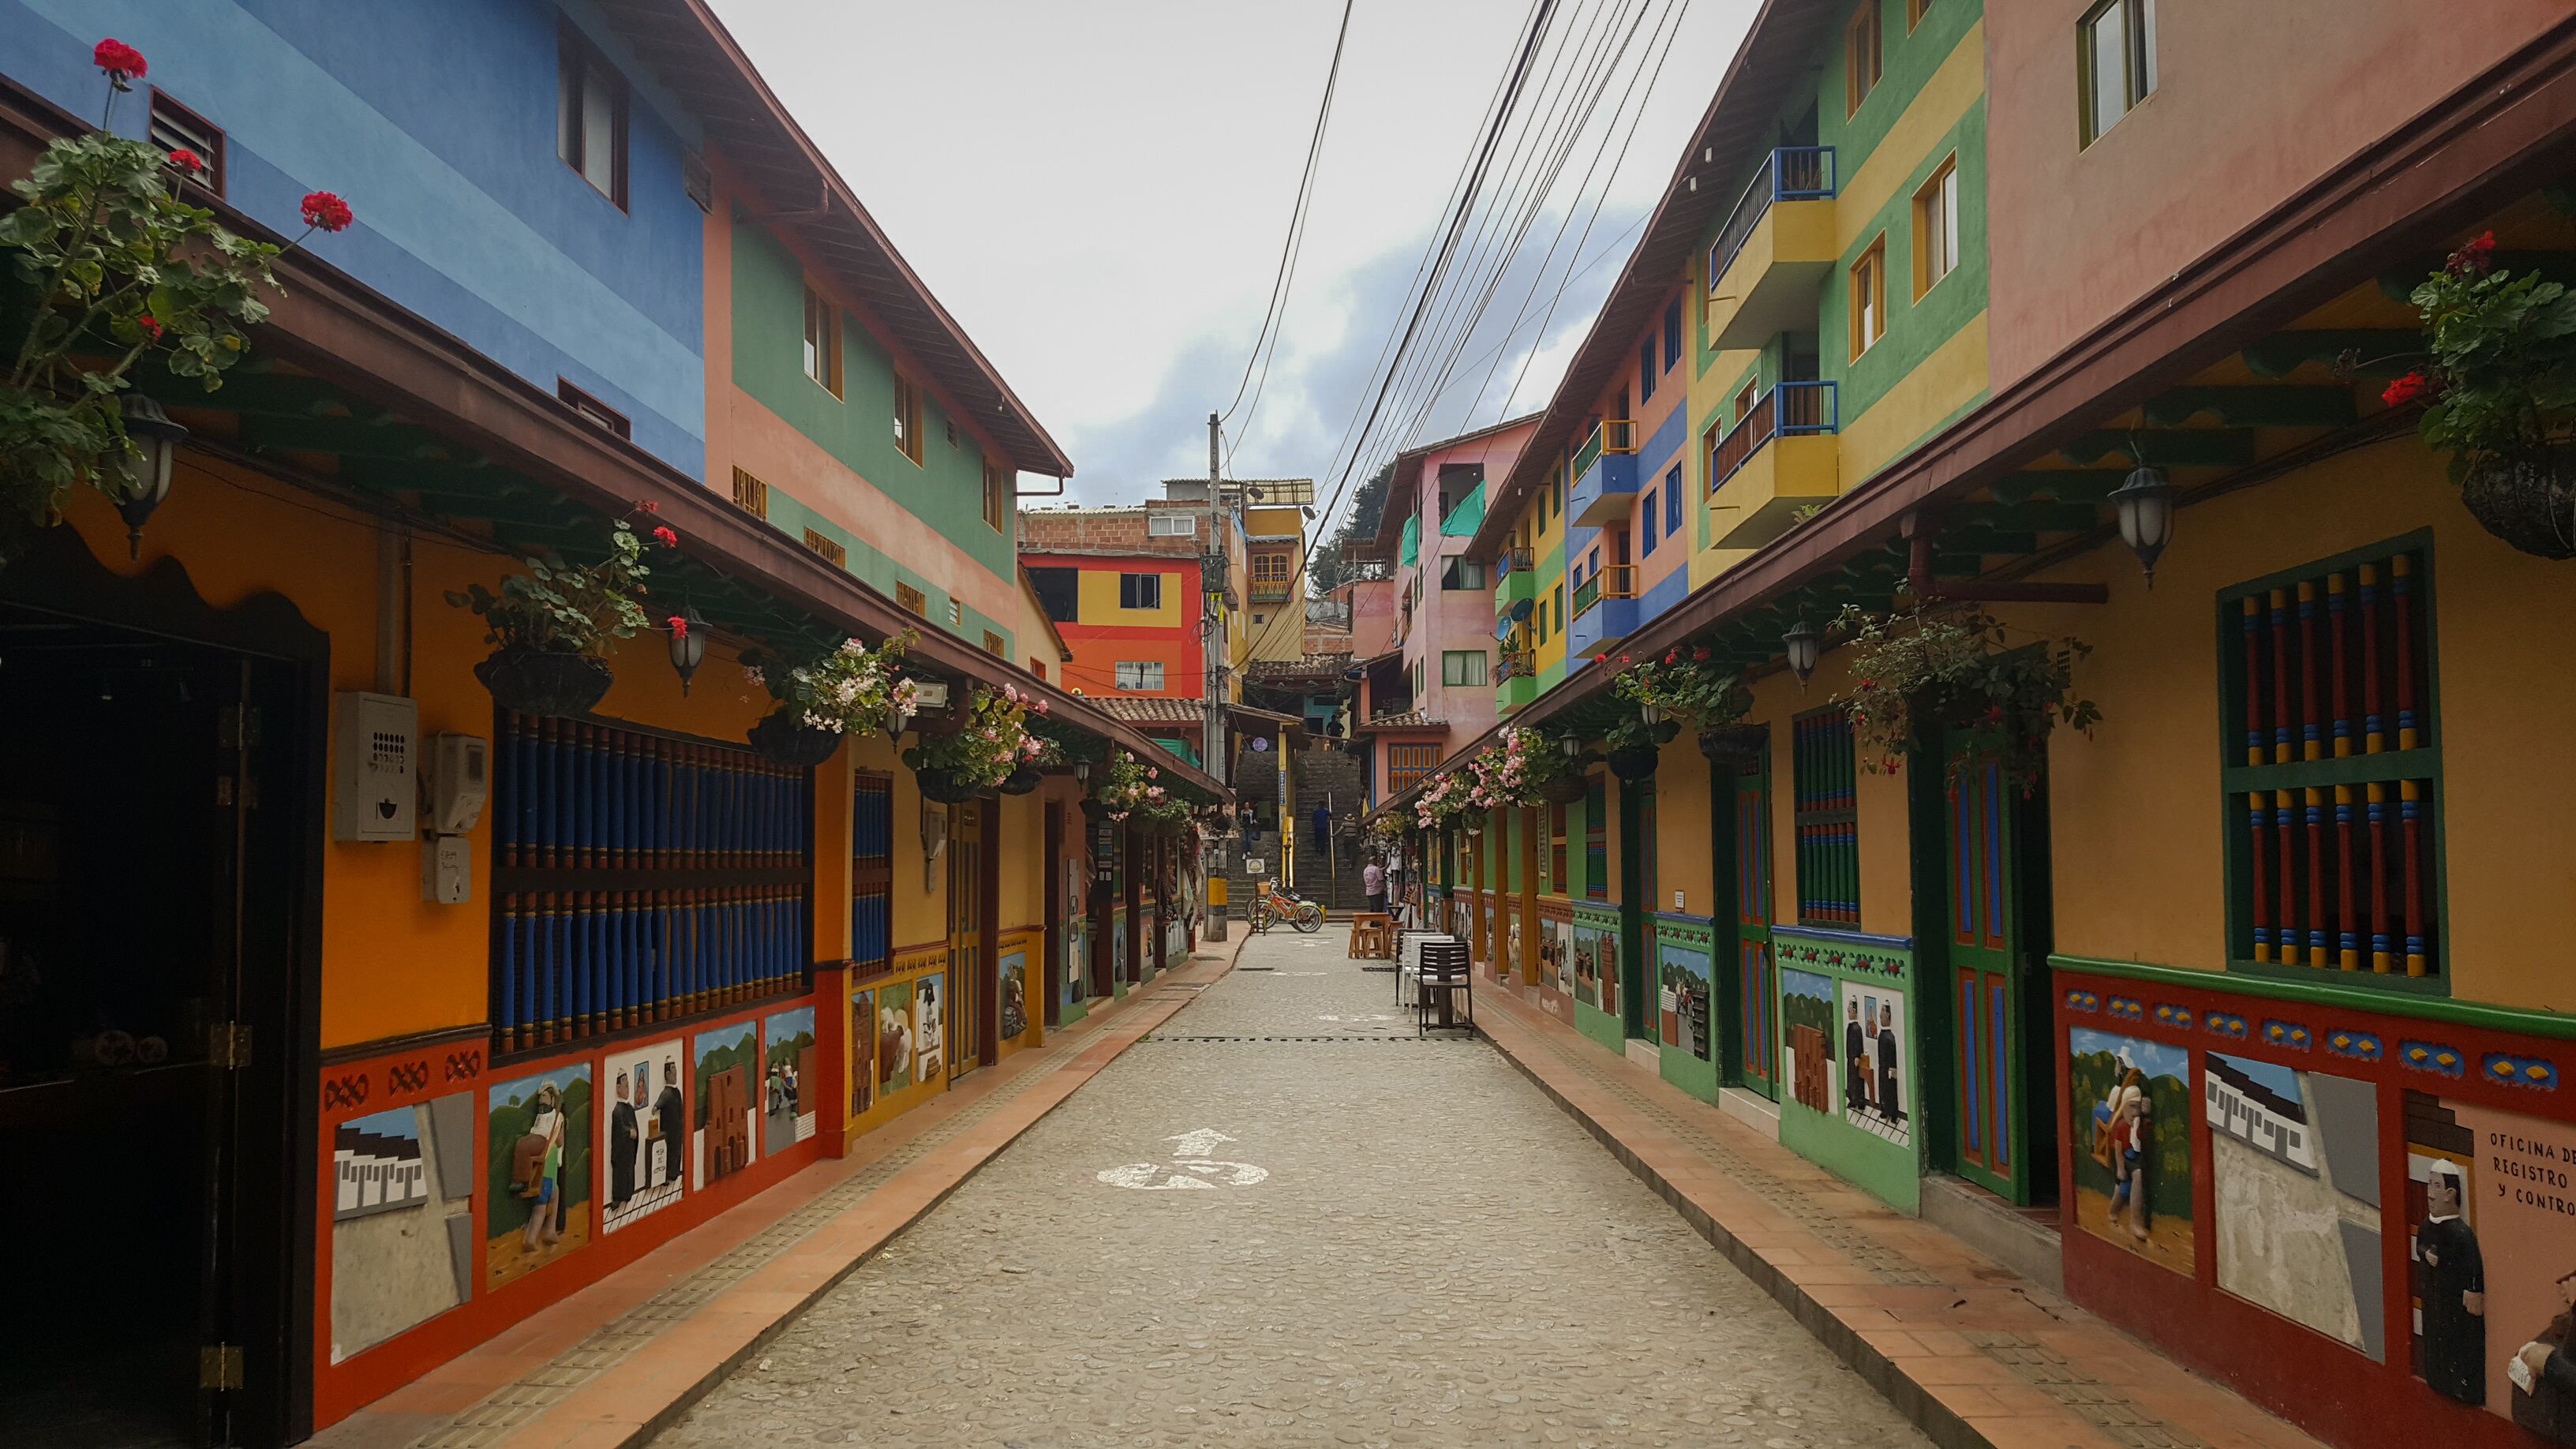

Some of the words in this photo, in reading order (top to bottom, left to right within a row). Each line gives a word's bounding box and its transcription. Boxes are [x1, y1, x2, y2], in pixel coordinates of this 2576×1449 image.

[2490, 1133, 2555, 1159] OFICINA
[2562, 1147, 2576, 1165] DE
[2493, 1156, 2567, 1189] REGISTRO
